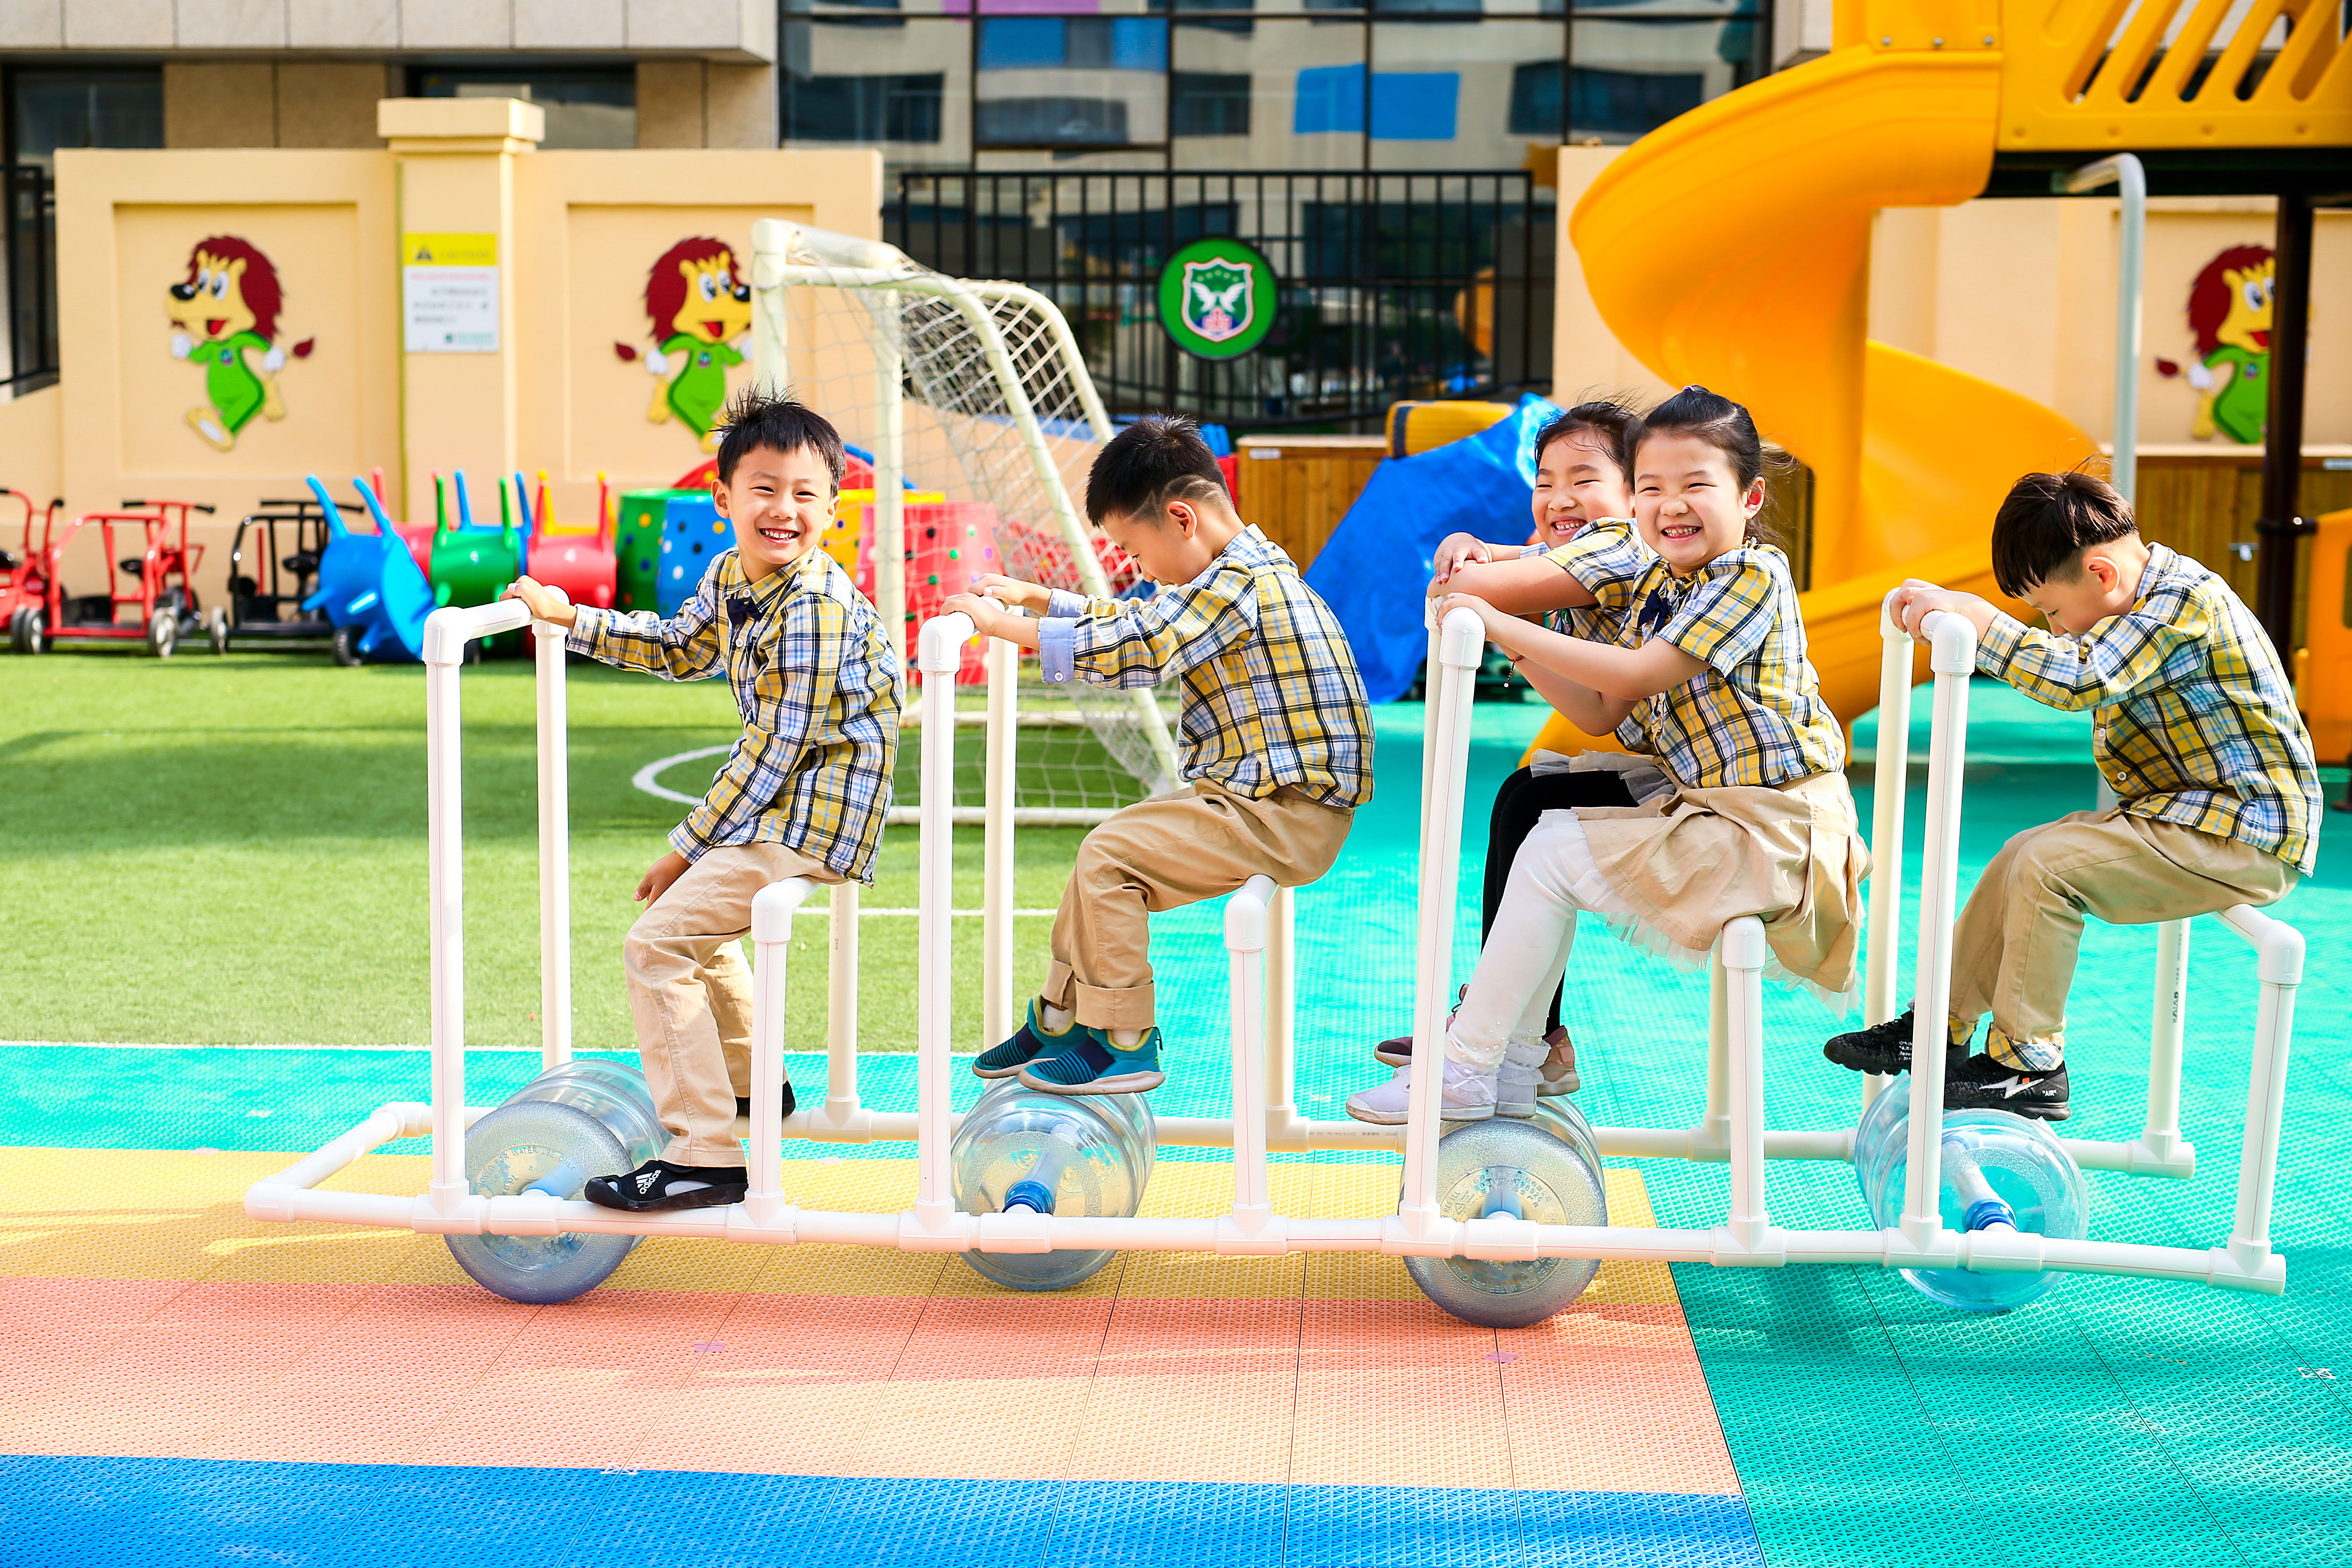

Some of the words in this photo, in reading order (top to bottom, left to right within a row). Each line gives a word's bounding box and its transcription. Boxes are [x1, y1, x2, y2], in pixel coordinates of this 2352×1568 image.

[495, 1153, 510, 1166] FOR
[512, 1147, 537, 1158] WATER
[559, 1156, 576, 1170] ONLY
[639, 1170, 661, 1194] adidas
[1445, 1190, 1460, 1213] REFILL
[1451, 1264, 1469, 1280] ONLY
[1489, 1284, 1517, 1293] WATER
[1520, 1278, 1536, 1289] FOR
